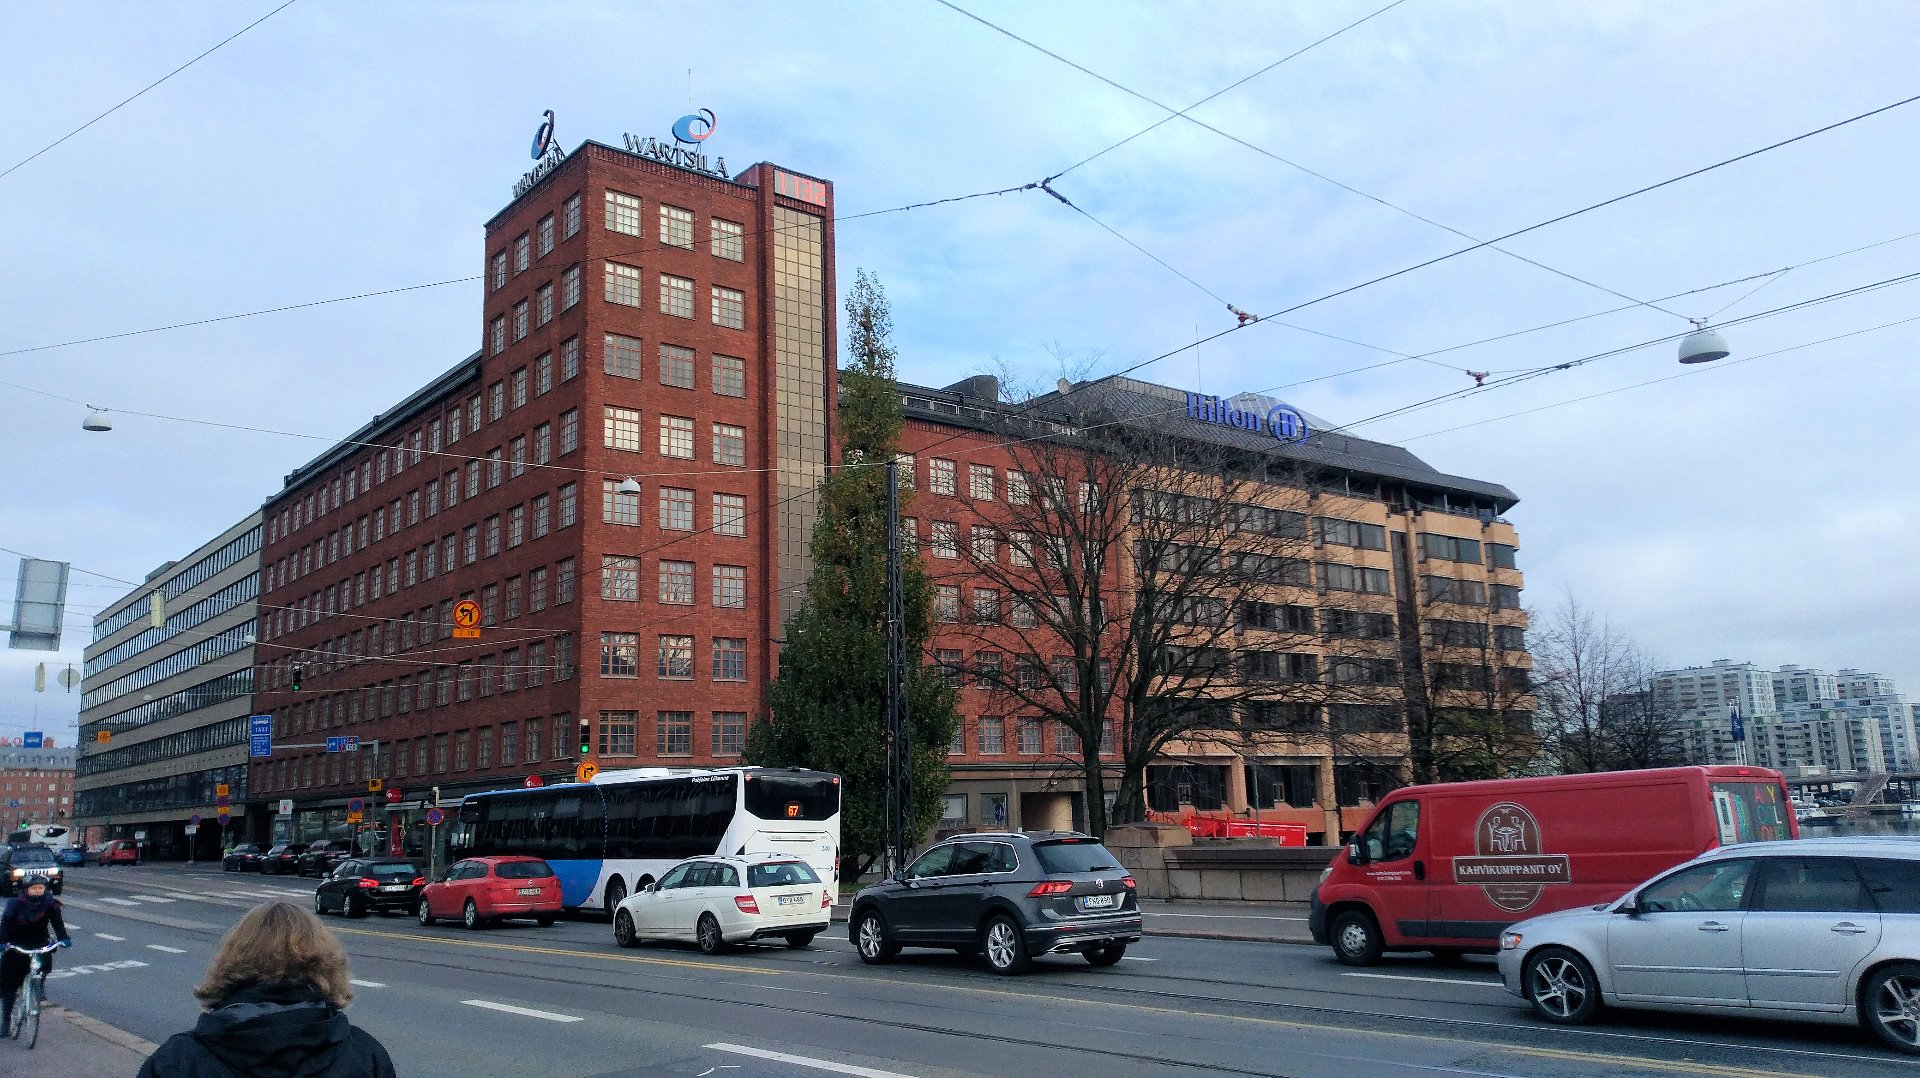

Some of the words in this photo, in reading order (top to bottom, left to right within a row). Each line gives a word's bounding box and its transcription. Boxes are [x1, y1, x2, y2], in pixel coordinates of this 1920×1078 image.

[622, 132, 730, 179] WÄRTSILÄ
[1186, 391, 1262, 433] Hilton
[788, 805, 799, 817] 67
[1458, 864, 1546, 876] KAHVIKUMPPANIT
[1547, 863, 1563, 875] OY
